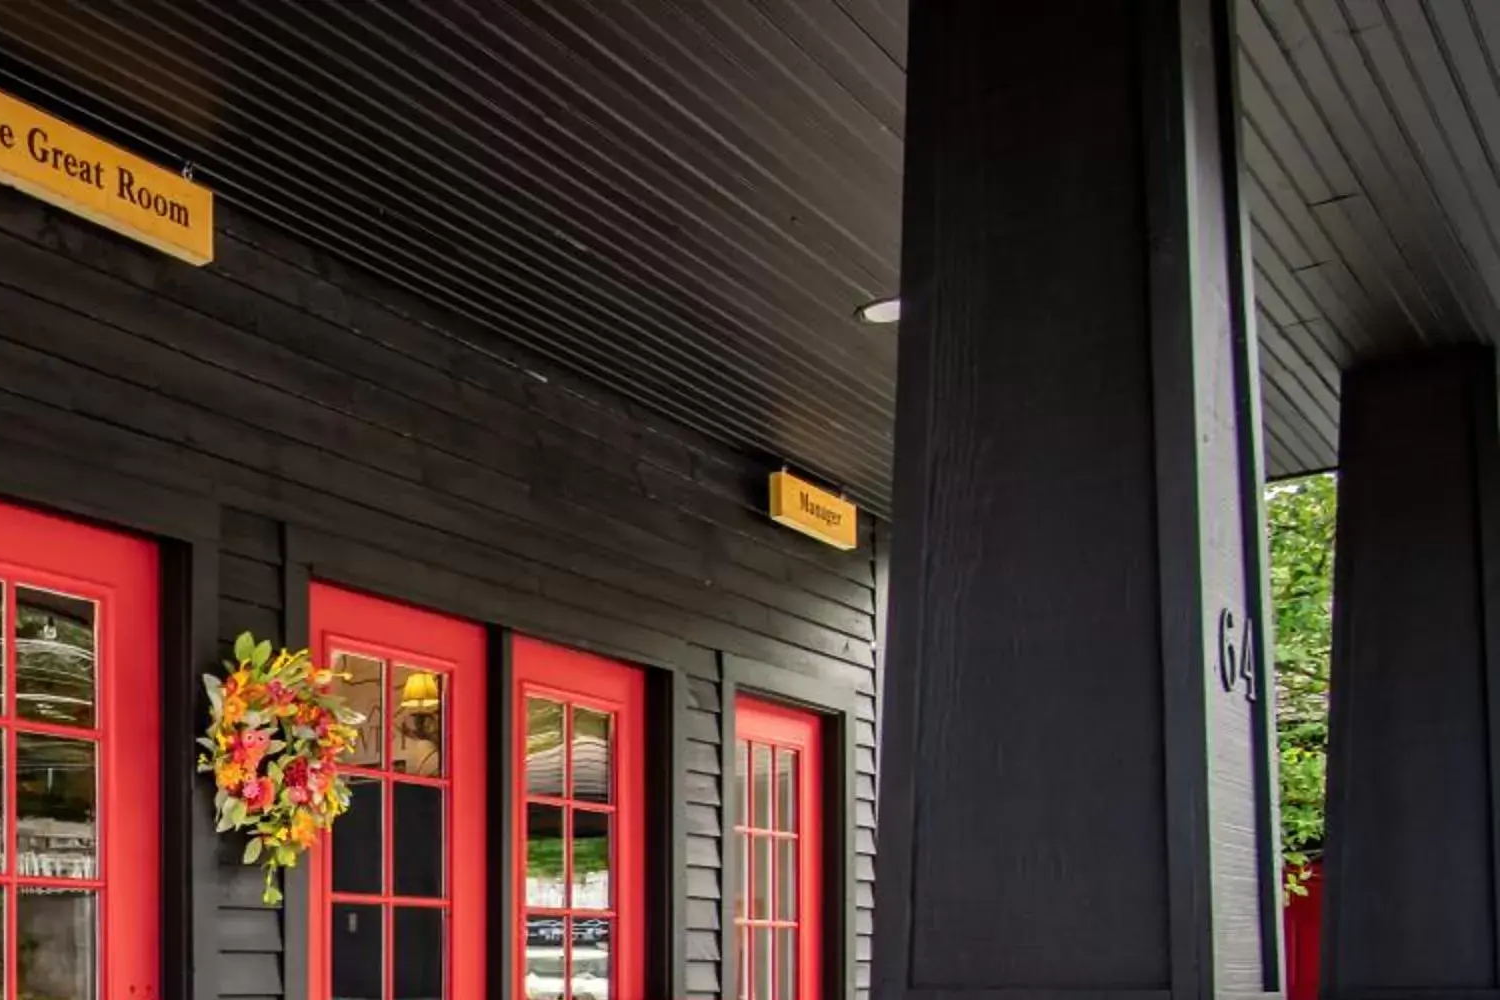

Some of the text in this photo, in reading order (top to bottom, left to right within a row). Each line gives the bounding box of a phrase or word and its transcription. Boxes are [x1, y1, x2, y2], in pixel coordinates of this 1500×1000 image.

[27, 127, 105, 190] Great
[117, 166, 191, 228] Room
[800, 490, 843, 526] Manager
[1218, 607, 1257, 703] 64
